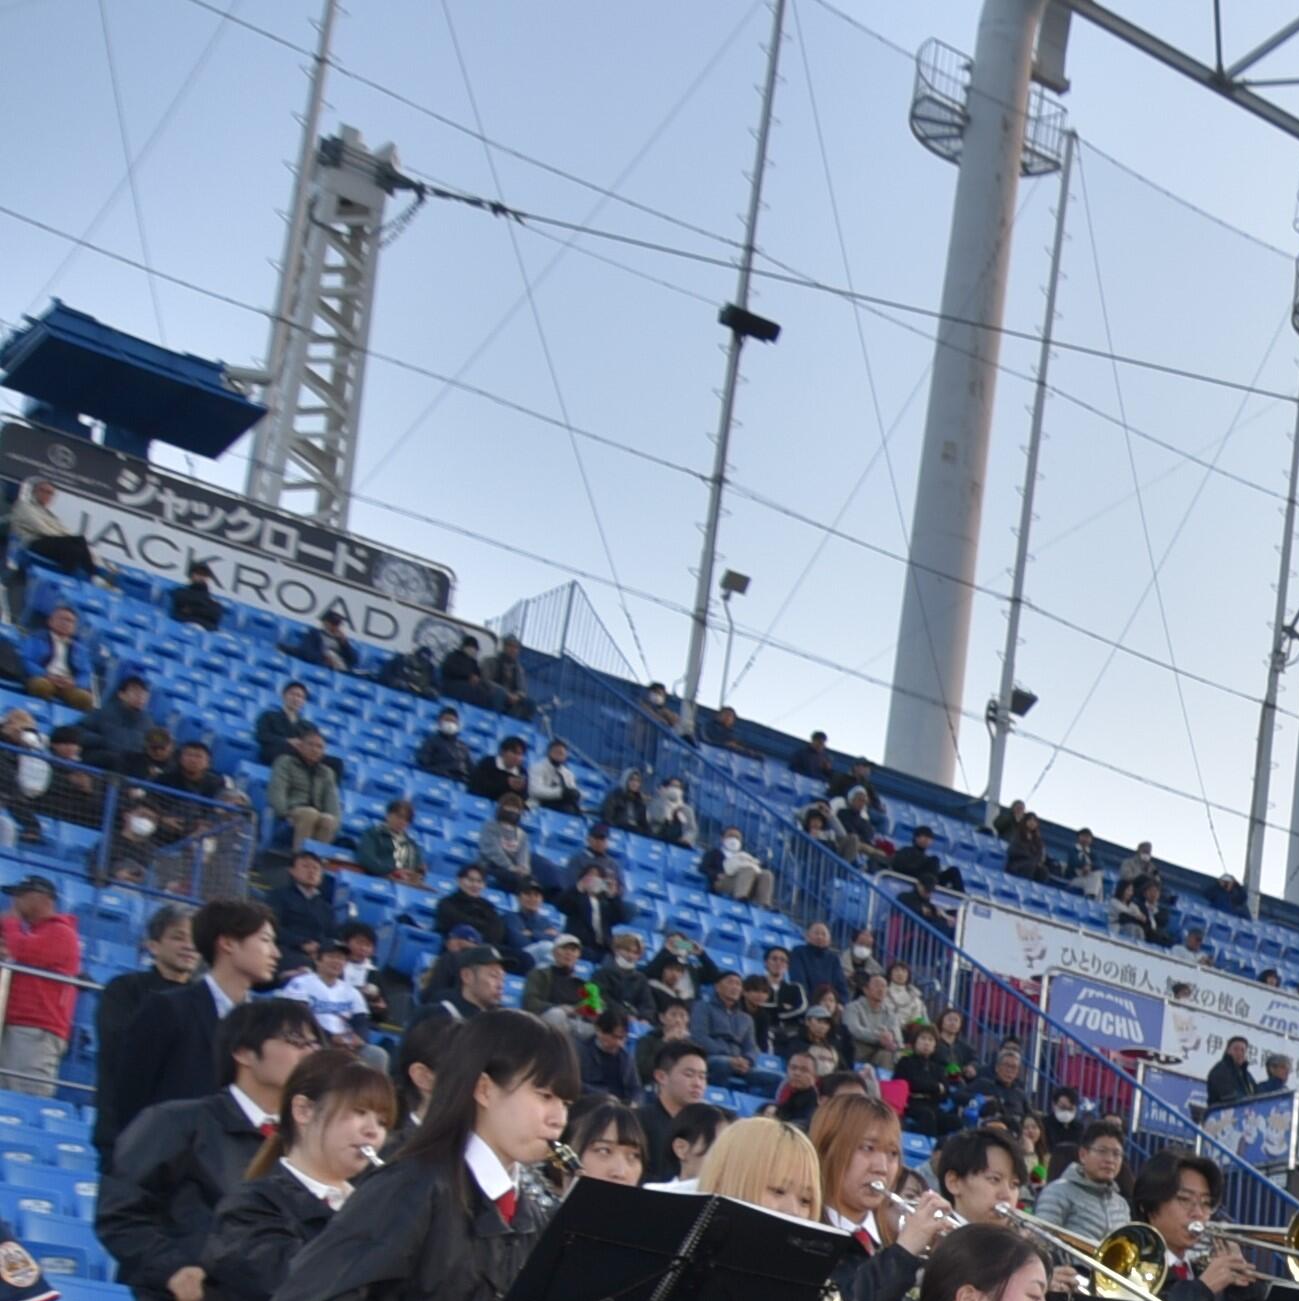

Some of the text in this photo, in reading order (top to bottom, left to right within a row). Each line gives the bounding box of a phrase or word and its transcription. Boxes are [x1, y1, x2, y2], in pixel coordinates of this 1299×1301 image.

[116, 468, 370, 578] ジャックロード
[1064, 1003, 1145, 1044] ITOCHU
